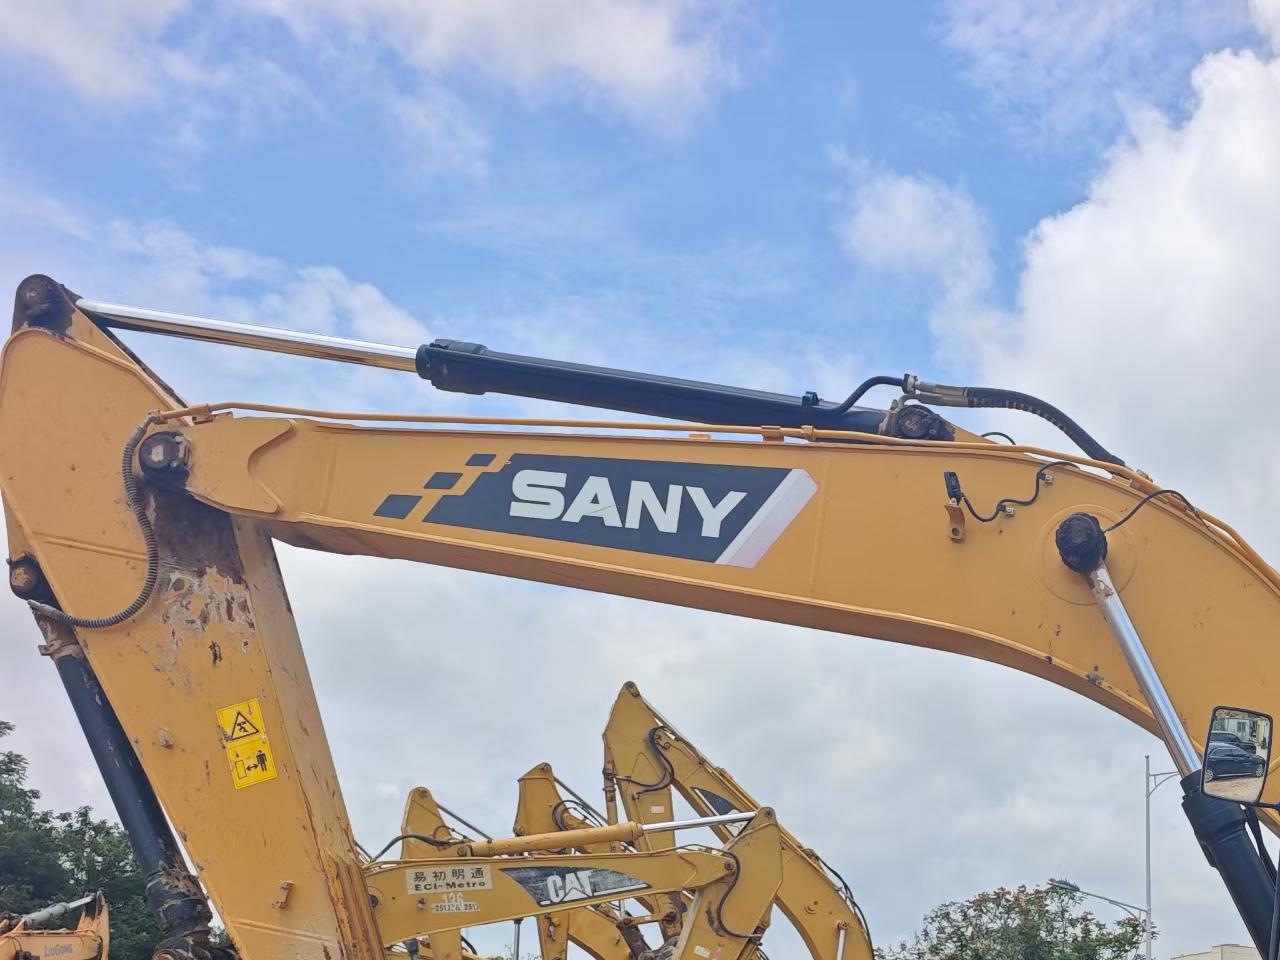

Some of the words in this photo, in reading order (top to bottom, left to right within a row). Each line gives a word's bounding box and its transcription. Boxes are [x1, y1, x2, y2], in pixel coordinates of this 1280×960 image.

[510, 469, 747, 538] SANY
[414, 867, 484, 882] 易初明通
[414, 882, 486, 891] ECI-Metro
[546, 869, 594, 903] CAT
